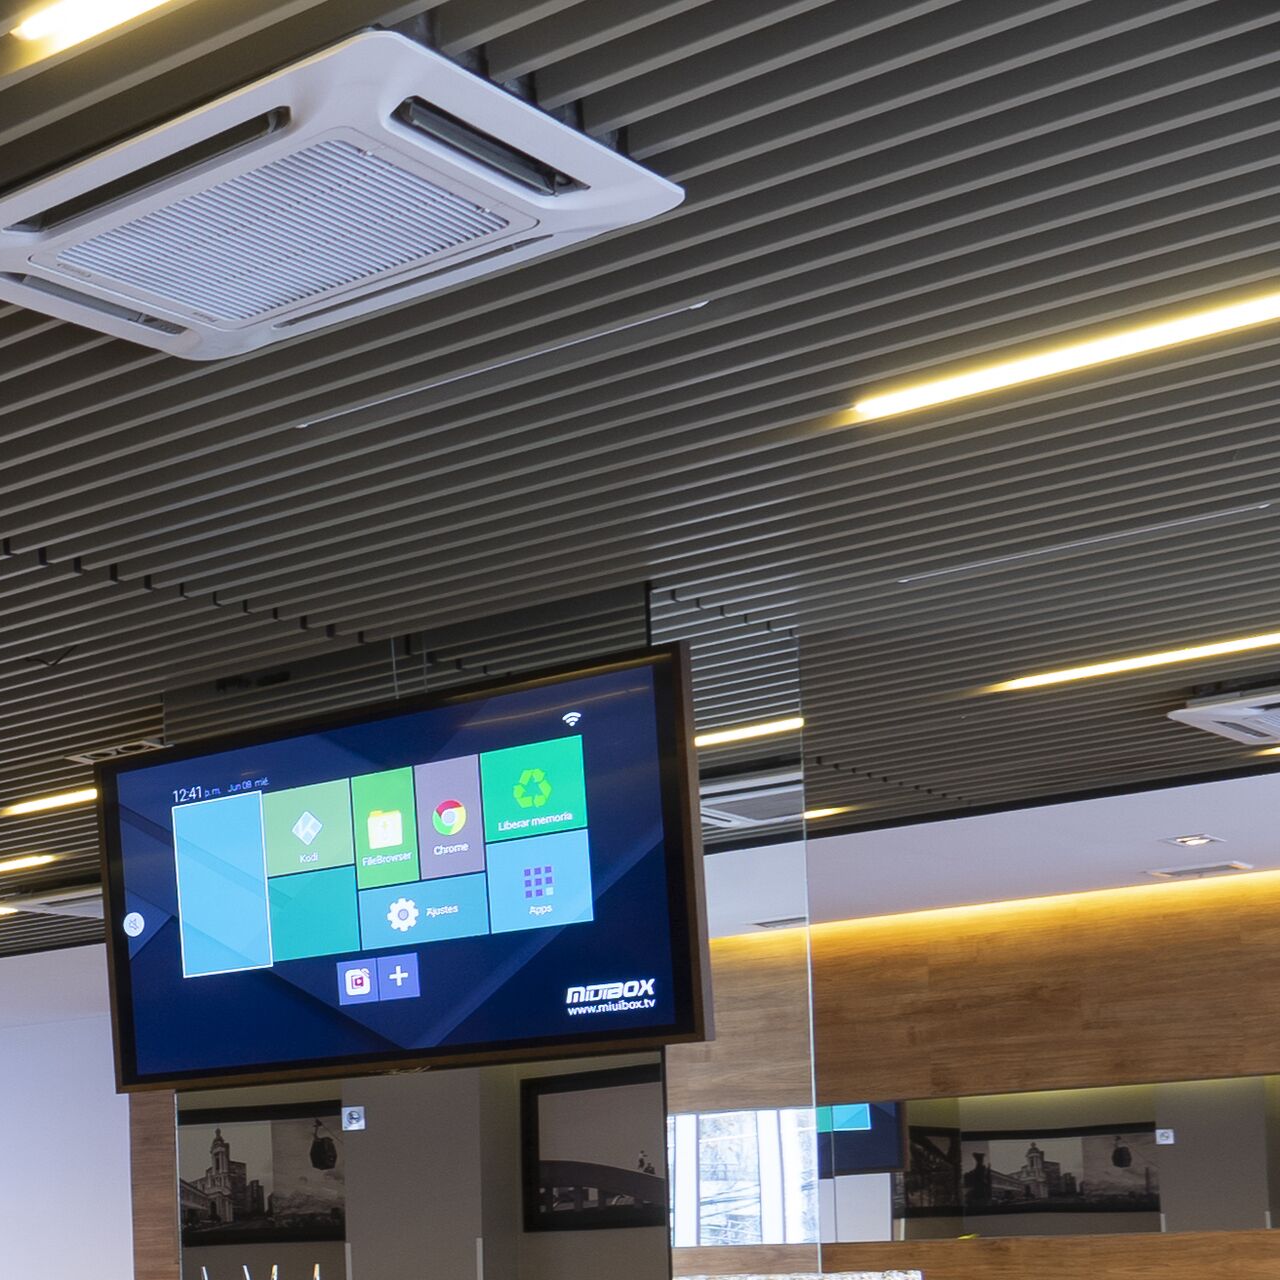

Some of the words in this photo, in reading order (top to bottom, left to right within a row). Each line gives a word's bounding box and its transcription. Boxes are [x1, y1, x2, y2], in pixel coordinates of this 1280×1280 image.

[173, 786, 202, 803] 12:41
[227, 783, 241, 793] Jun
[498, 816, 530, 832] Liberar
[531, 811, 573, 825] memoria
[433, 841, 469, 856] Chrome
[299, 852, 318, 864] Kodi
[362, 851, 413, 867] FileBrowser
[426, 904, 459, 917] Ajustes
[529, 903, 553, 916] Apps
[567, 998, 656, 1016] www.miuibox.tv
